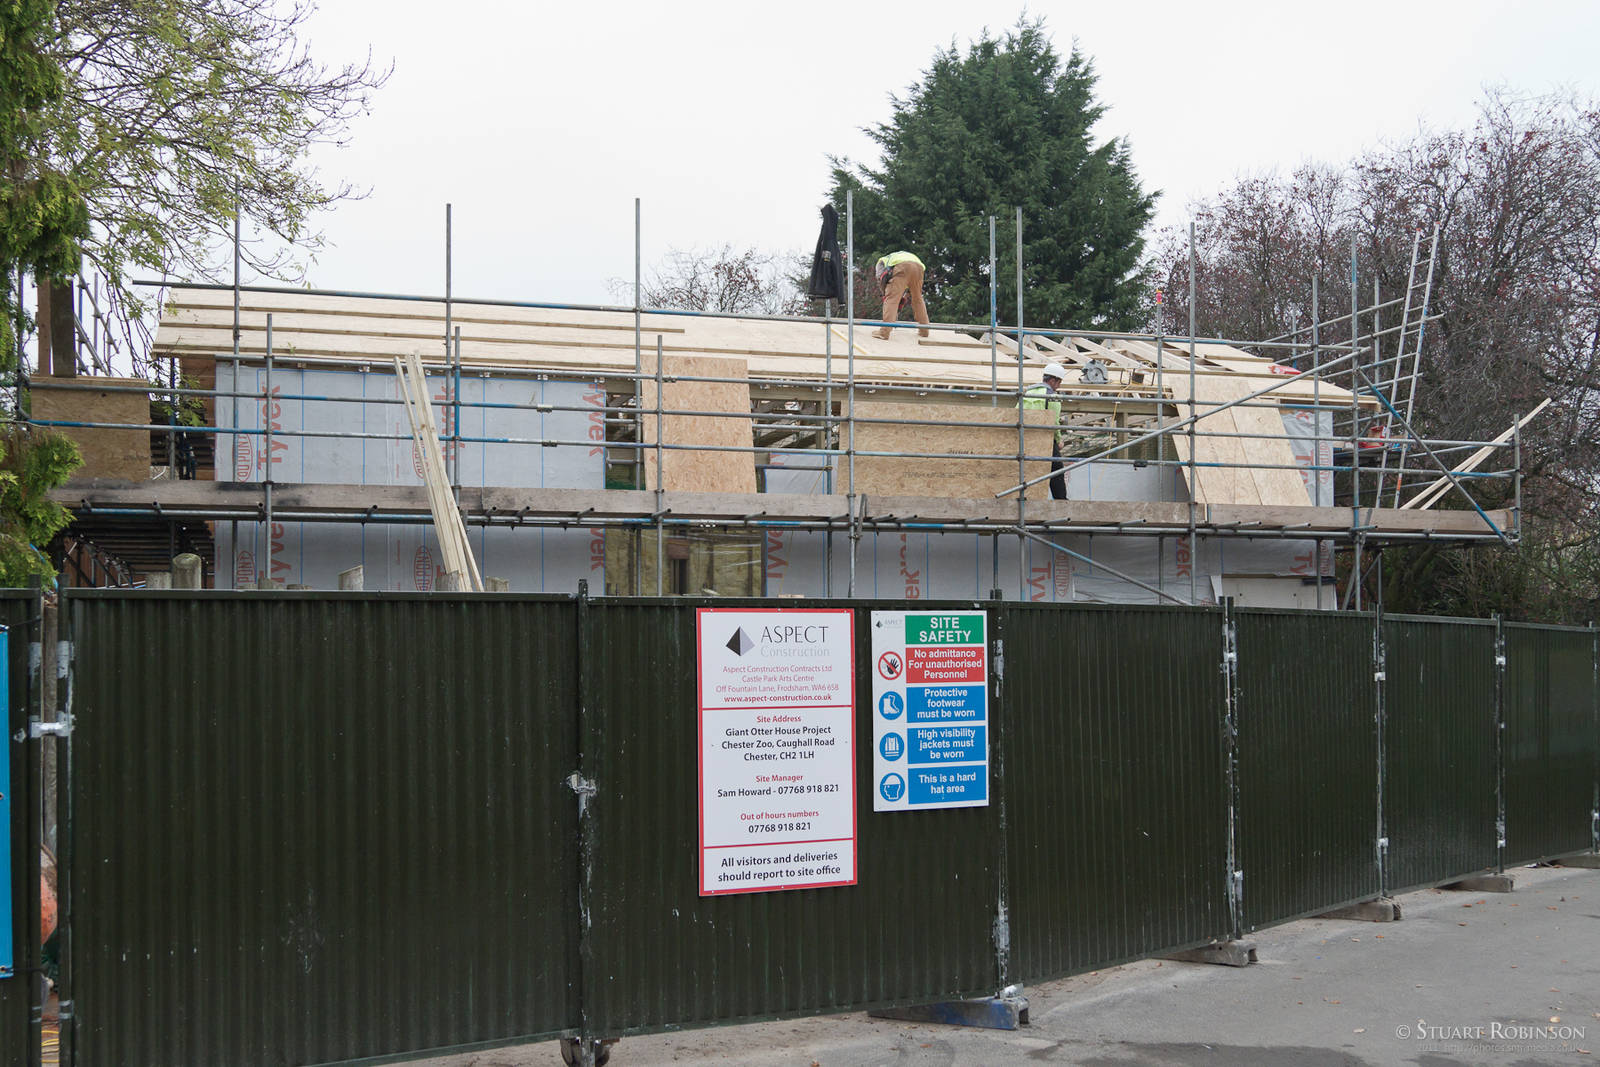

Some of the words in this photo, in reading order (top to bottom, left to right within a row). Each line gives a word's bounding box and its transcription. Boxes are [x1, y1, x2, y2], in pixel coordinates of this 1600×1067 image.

[930, 617, 960, 629] SITE
[761, 625, 829, 644] ASPECT
[919, 630, 971, 642] SAFETY
[761, 646, 830, 657] Construction
[914, 649, 927, 658] No
[928, 649, 976, 658] admittance
[722, 665, 746, 674] Aspect
[746, 665, 789, 673] Construction
[790, 665, 821, 673] Contracts
[908, 660, 923, 669] For
[925, 659, 982, 669] unauthorised
[742, 675, 762, 683] Castle
[793, 674, 814, 682] Centre
[924, 670, 968, 679] Personnel
[716, 685, 727, 693] Off
[759, 685, 776, 693] Lane,
[924, 688, 968, 697] Protective
[724, 693, 832, 704] www.aspect-construction.co.uk
[927, 698, 965, 708] footwear
[772, 715, 801, 723] Address
[917, 710, 939, 719] must
[941, 709, 952, 718] be
[953, 709, 976, 717] worn
[725, 728, 749, 737] Giant
[750, 727, 774, 736] Otter
[774, 727, 801, 735] House
[802, 726, 832, 736] Project
[917, 729, 938, 740] High
[939, 728, 976, 739] visibility
[721, 740, 754, 749] Chester
[756, 740, 775, 749] Zoo,
[776, 738, 813, 749] Caughall
[814, 737, 835, 746] Road
[919, 740, 951, 751] jackets
[952, 739, 974, 748] must
[743, 752, 778, 762] Chester,
[779, 751, 797, 760] CH2
[799, 751, 814, 759] 1LH
[930, 751, 941, 759] be
[942, 750, 964, 759] worn
[755, 775, 771, 783] Site
[771, 775, 803, 783] Manager
[918, 774, 938, 784] This
[939, 773, 948, 783] is
[956, 772, 976, 781] hard
[717, 788, 736, 797] Sam
[738, 787, 772, 797] Howard
[778, 785, 805, 795] 07768
[806, 784, 823, 793] 918
[824, 784, 839, 792] 821
[930, 785, 945, 794] hat
[946, 784, 965, 793] area
[740, 812, 755, 821] Out
[756, 812, 764, 820] of
[765, 811, 786, 820] hours
[787, 810, 819, 818] numbers
[748, 823, 776, 833] 07768
[777, 822, 794, 832] 918
[795, 822, 811, 831] 821
[721, 857, 734, 867] All
[736, 855, 772, 866] visitors
[773, 854, 791, 864] and
[793, 851, 838, 863] deliveries
[718, 871, 751, 882] should
[753, 869, 784, 881] report
[785, 868, 795, 878] to
[797, 867, 814, 876] site
[816, 865, 841, 875] office
